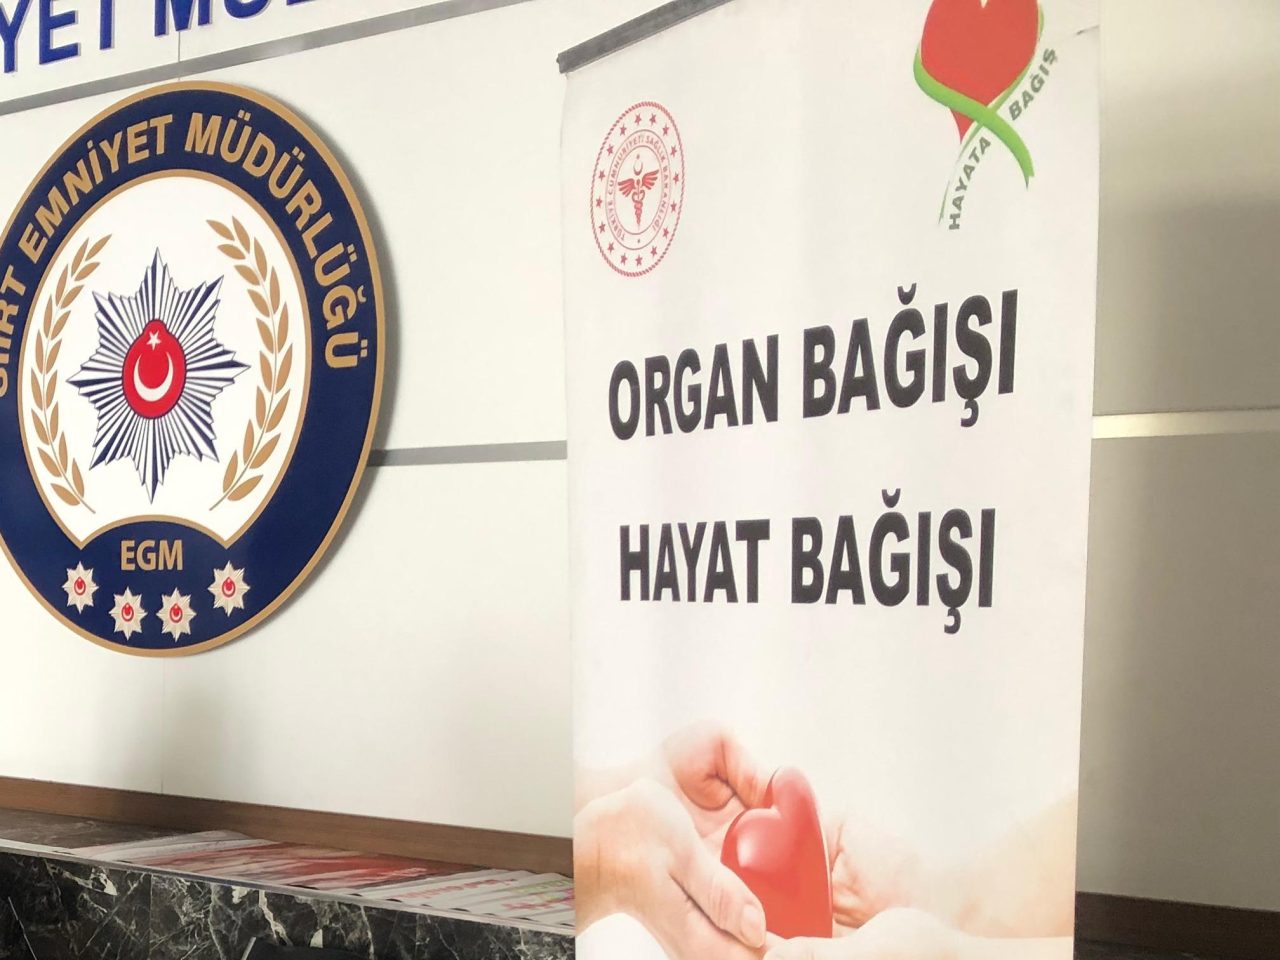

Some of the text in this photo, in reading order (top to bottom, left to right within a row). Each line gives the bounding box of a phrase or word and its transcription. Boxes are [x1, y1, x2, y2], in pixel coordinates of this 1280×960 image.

[949, 48, 1058, 230] HAYATA BAĞIŞ
[18, 114, 173, 264] EMNİYET
[185, 110, 368, 369] MÜDÜRLÜĞÜ
[608, 282, 1019, 440] ORGAN BAĞIŞI
[120, 539, 183, 571] EGM
[620, 487, 996, 634] HAYAT BAĞIŞI
